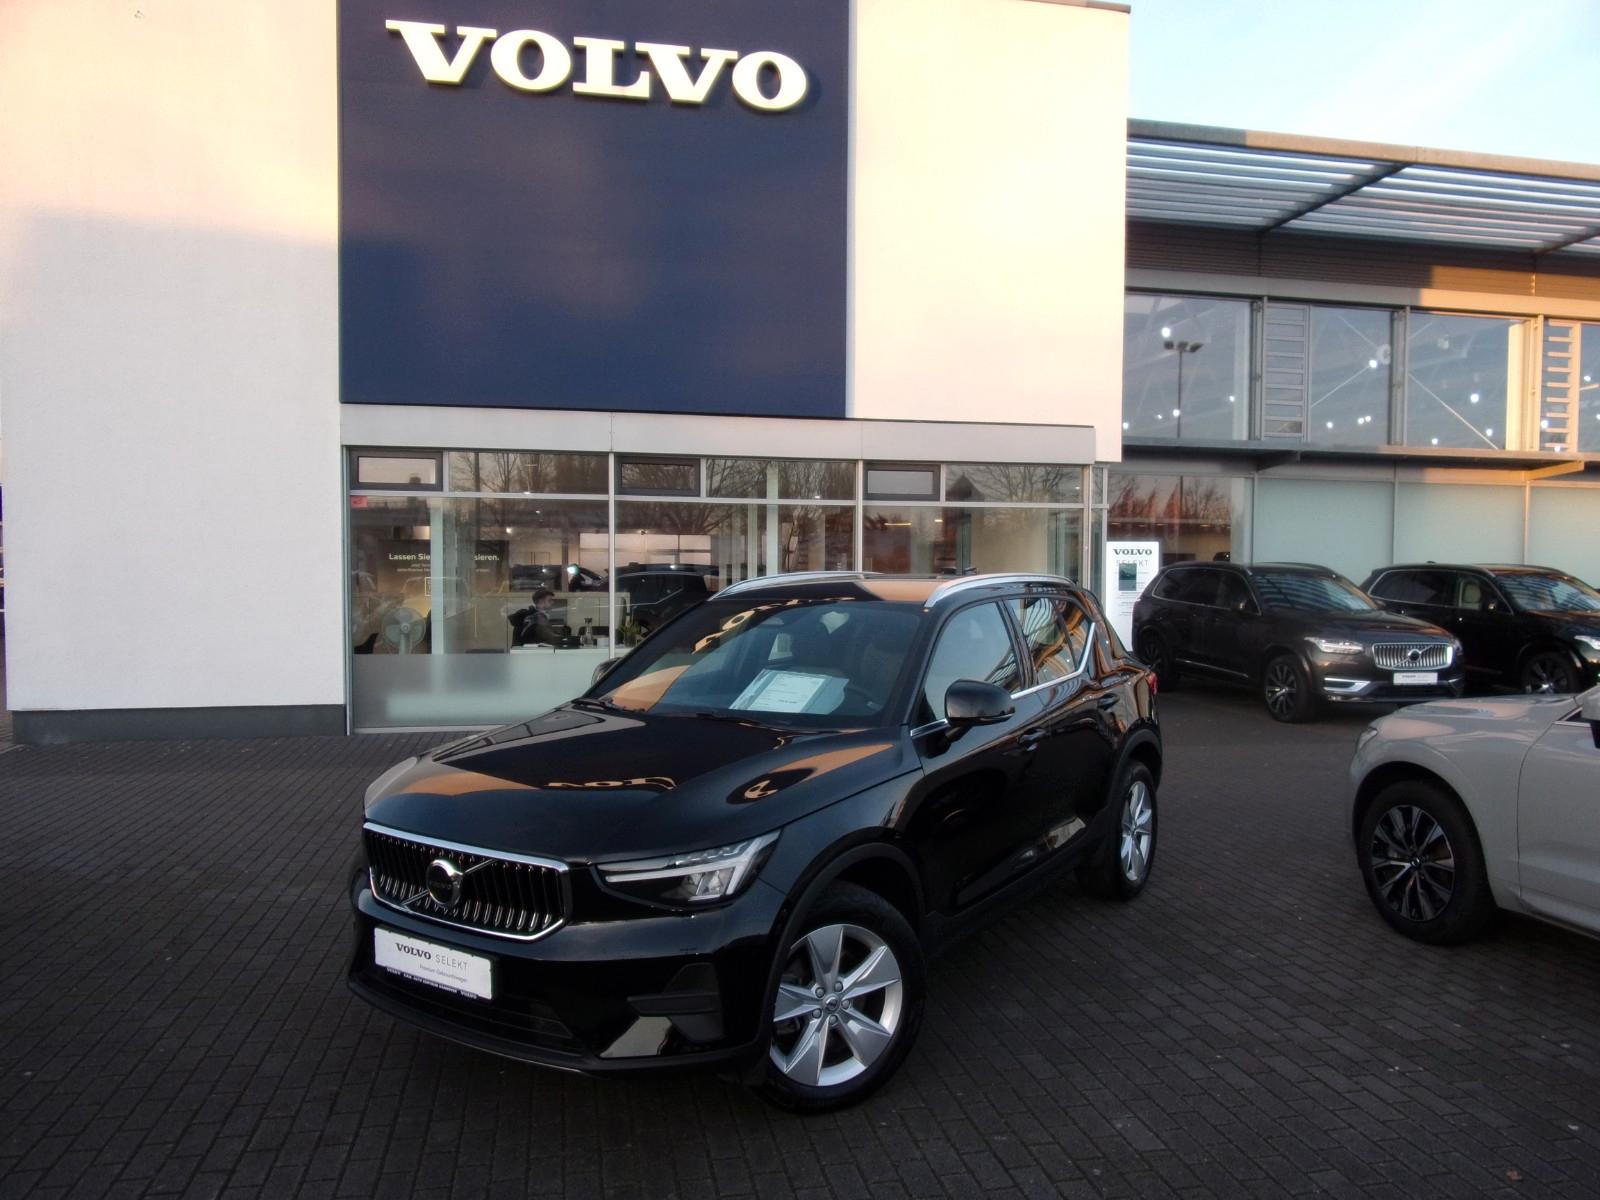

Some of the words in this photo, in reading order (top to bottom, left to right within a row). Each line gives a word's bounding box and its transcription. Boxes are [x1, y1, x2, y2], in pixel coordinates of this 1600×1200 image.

[385, 19, 808, 111] VOLVO
[388, 553, 416, 561] Lassen
[417, 553, 431, 561] Sie
[1113, 548, 1152, 556] VOLVO
[395, 942, 431, 960] VOLVO
[435, 953, 468, 970] SELEKT
